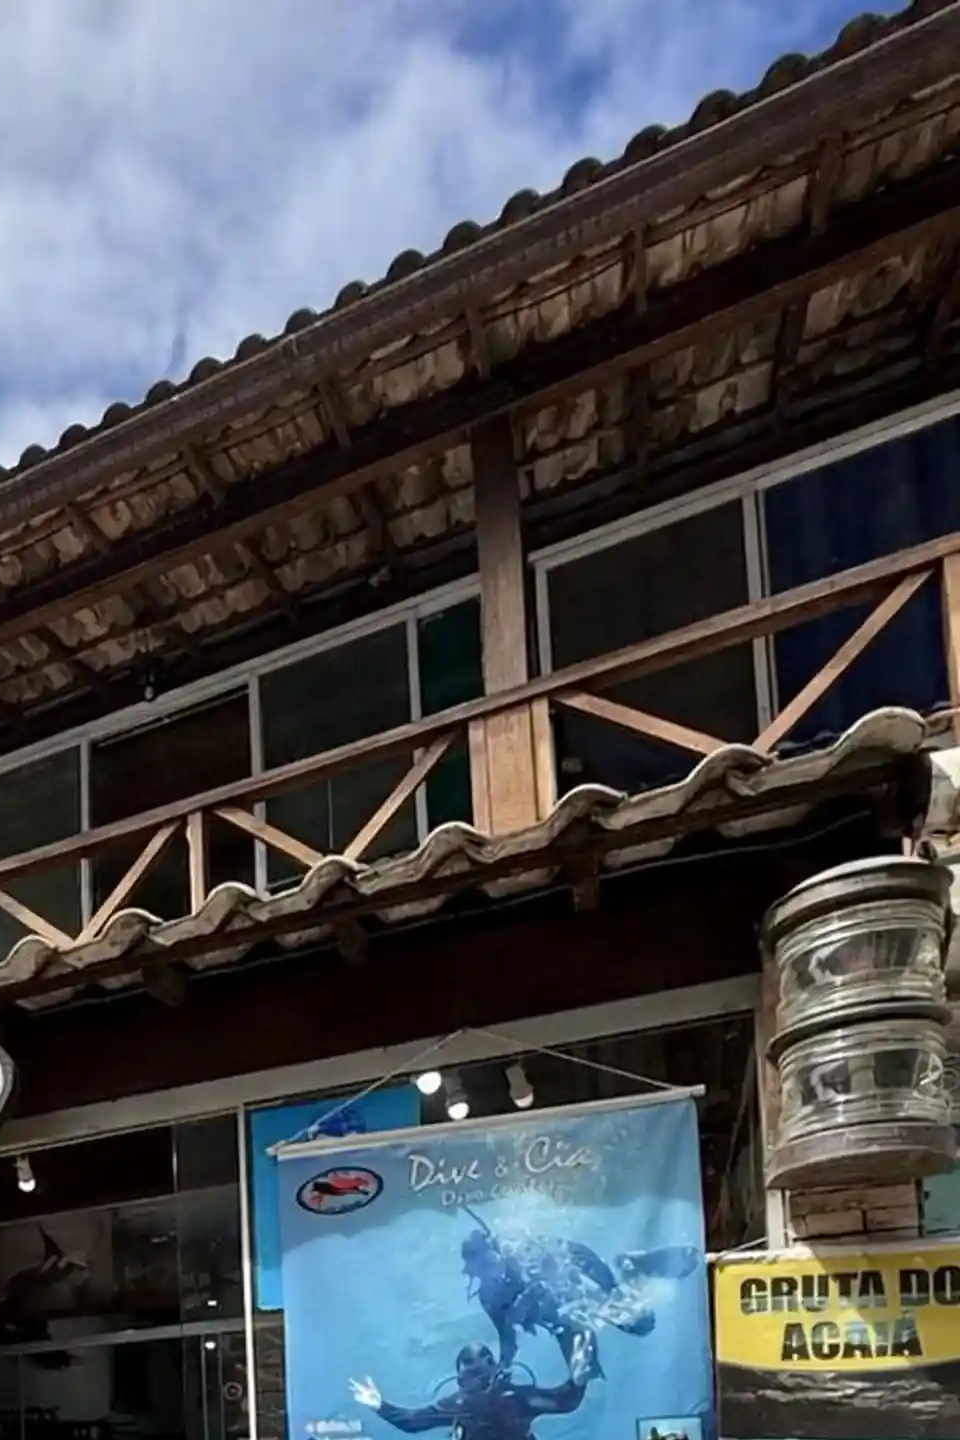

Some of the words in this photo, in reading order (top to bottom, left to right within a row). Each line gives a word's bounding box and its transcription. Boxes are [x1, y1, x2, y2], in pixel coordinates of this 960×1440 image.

[408, 1154, 482, 1191] Dive
[740, 1269, 888, 1315] GRUTA
[899, 1265, 960, 1306] DO
